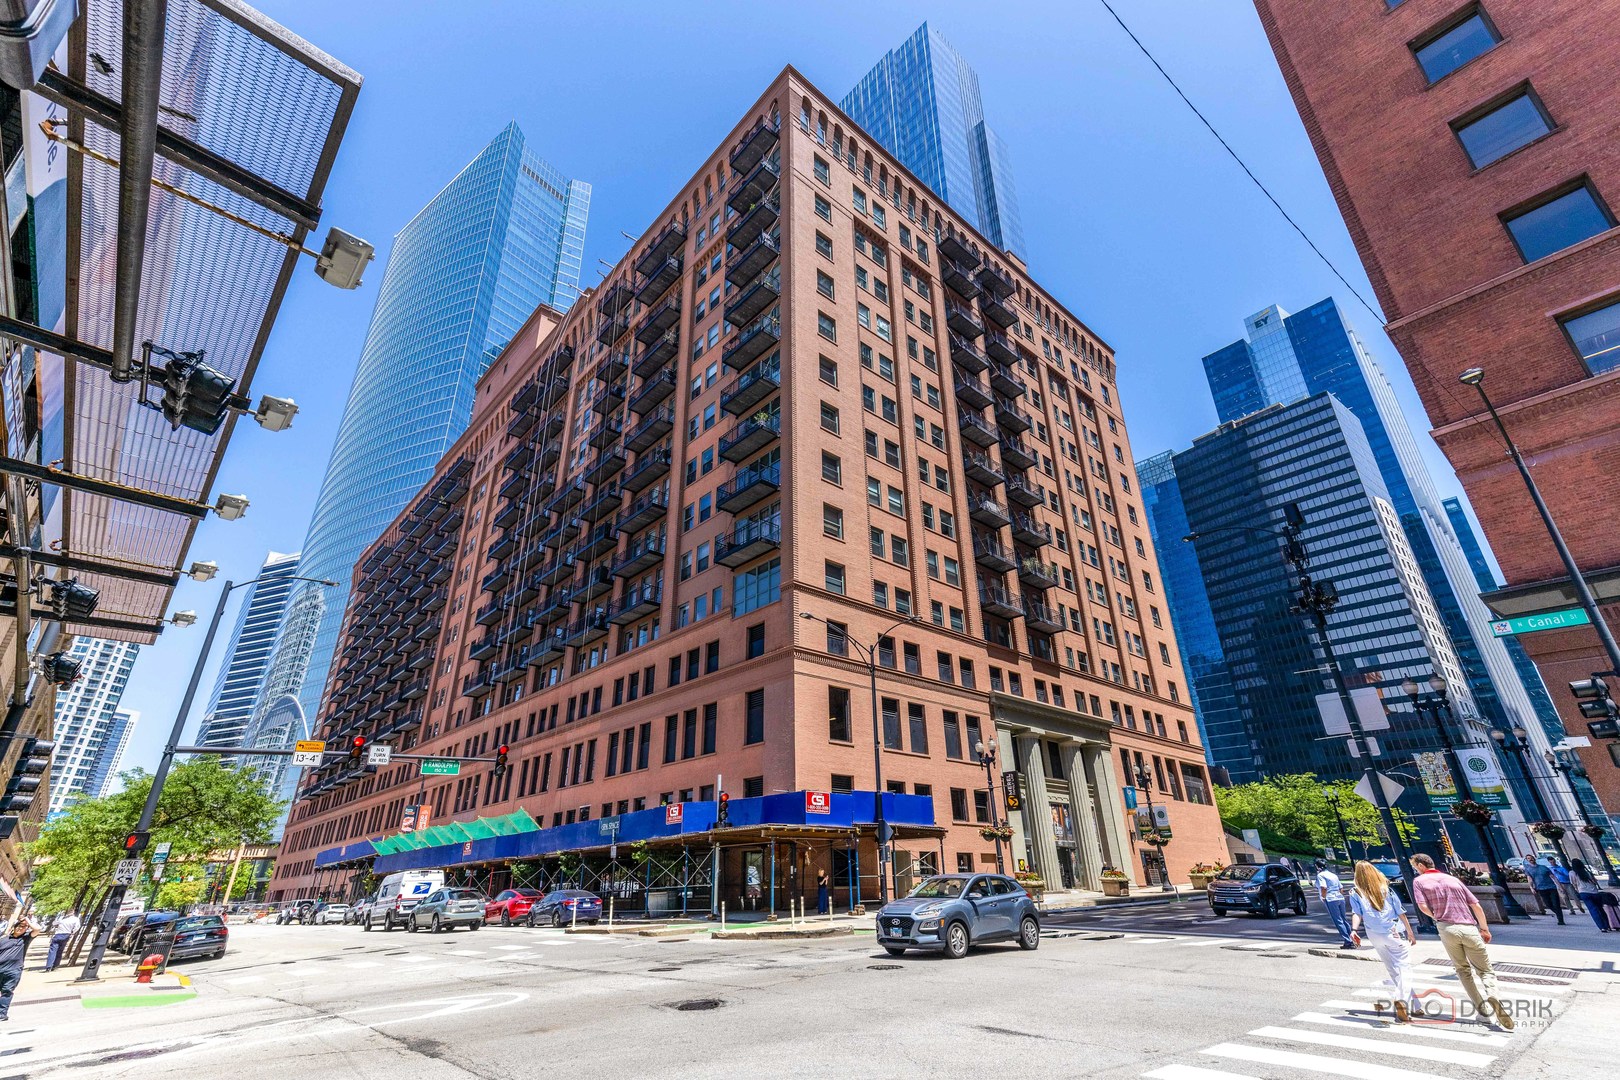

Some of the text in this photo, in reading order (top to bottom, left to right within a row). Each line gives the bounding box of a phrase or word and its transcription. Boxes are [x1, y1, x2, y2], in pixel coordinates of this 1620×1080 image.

[1254, 315, 1269, 329] EY
[1527, 614, 1565, 629] Canal
[1569, 613, 1578, 621] St
[811, 794, 825, 806] CSI
[121, 860, 139, 868] ONE
[118, 867, 137, 875] WAY
